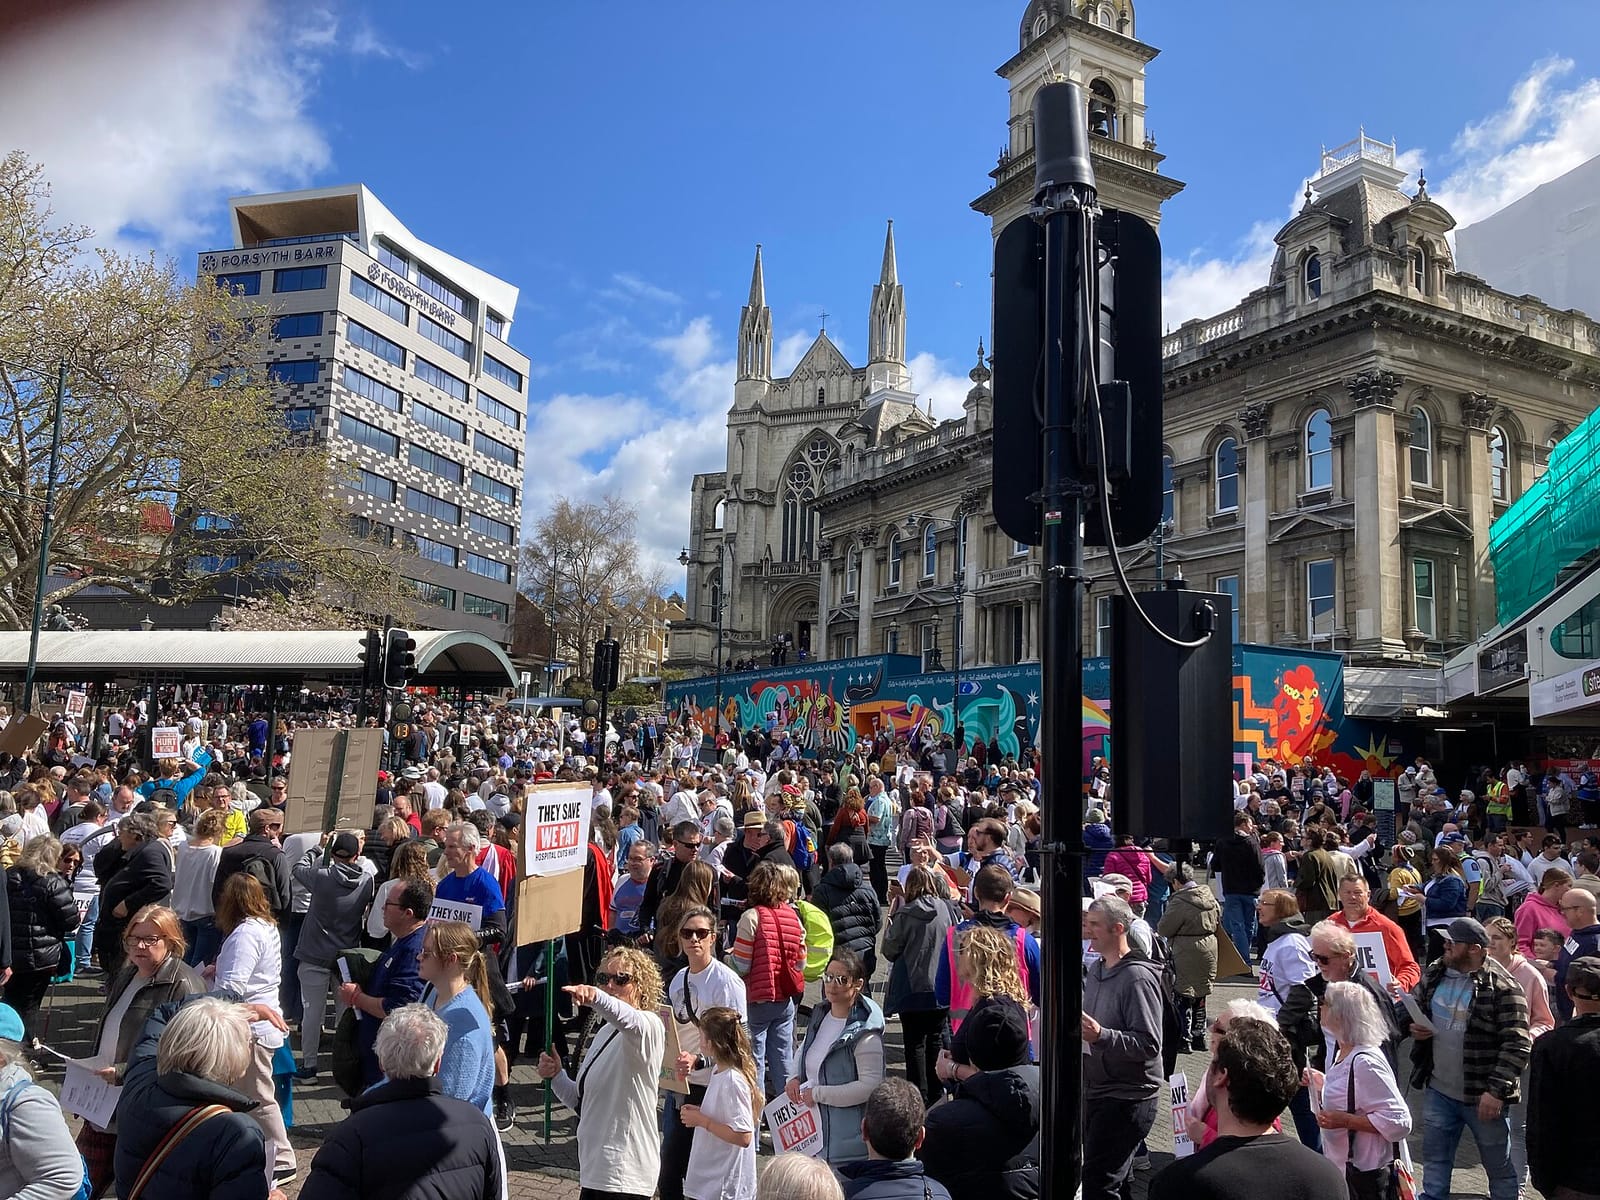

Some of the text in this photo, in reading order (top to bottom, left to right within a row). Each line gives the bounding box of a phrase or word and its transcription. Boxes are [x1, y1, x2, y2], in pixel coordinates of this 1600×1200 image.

[221, 246, 336, 267] FORSYTH BARR
[381, 272, 456, 328] FORSYTH BARR
[396, 723, 408, 738] 13
[156, 737, 176, 746] HURT
[538, 802, 581, 823] THEY SAVE
[541, 823, 577, 849] WE PAY
[535, 848, 578, 862] HOSPITAL CUTS HURT
[431, 905, 452, 920] THEY
[453, 909, 472, 923] SAVE
[1172, 1085, 1187, 1106] AVE
[773, 1103, 792, 1127] THEY
[783, 1112, 813, 1147] WE PAY
